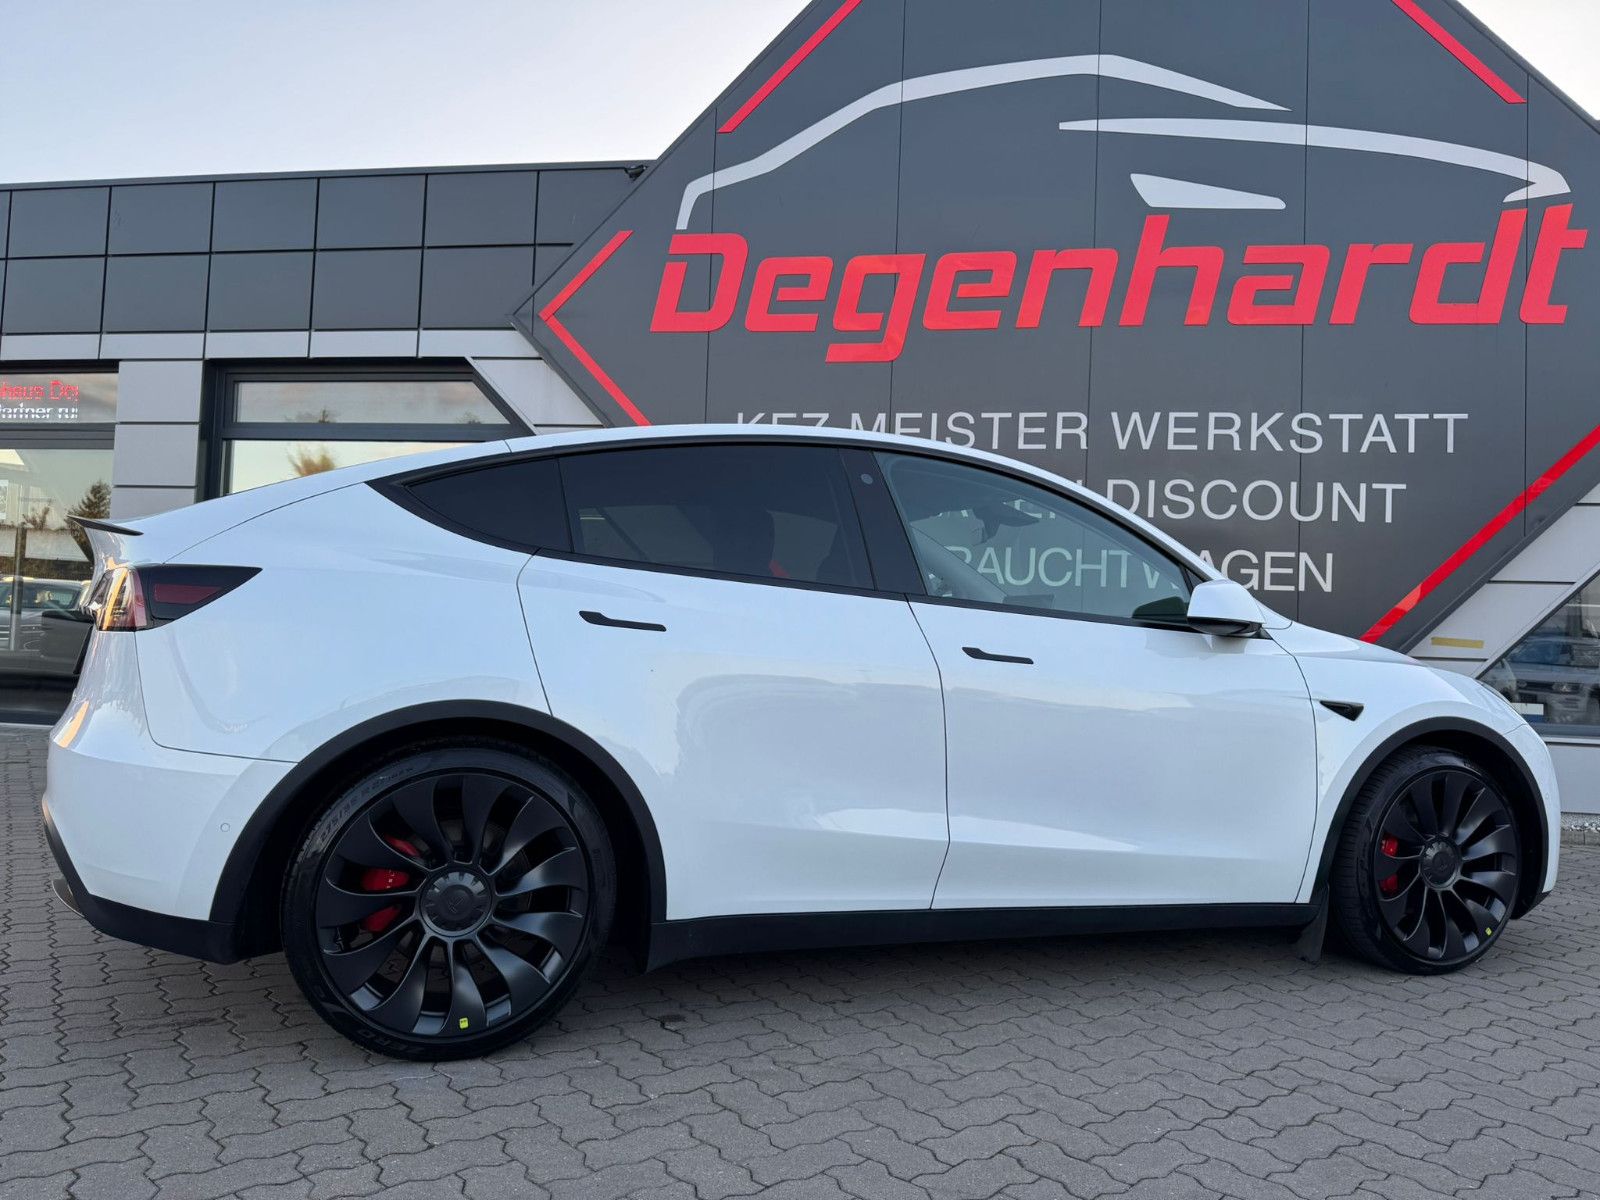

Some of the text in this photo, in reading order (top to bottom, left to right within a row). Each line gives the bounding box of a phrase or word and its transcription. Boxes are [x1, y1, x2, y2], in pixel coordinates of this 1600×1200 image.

[650, 203, 1588, 363] Degenhardt
[1110, 411, 1469, 454] WERKSTATT
[1106, 478, 1407, 523] DISCOUNT
